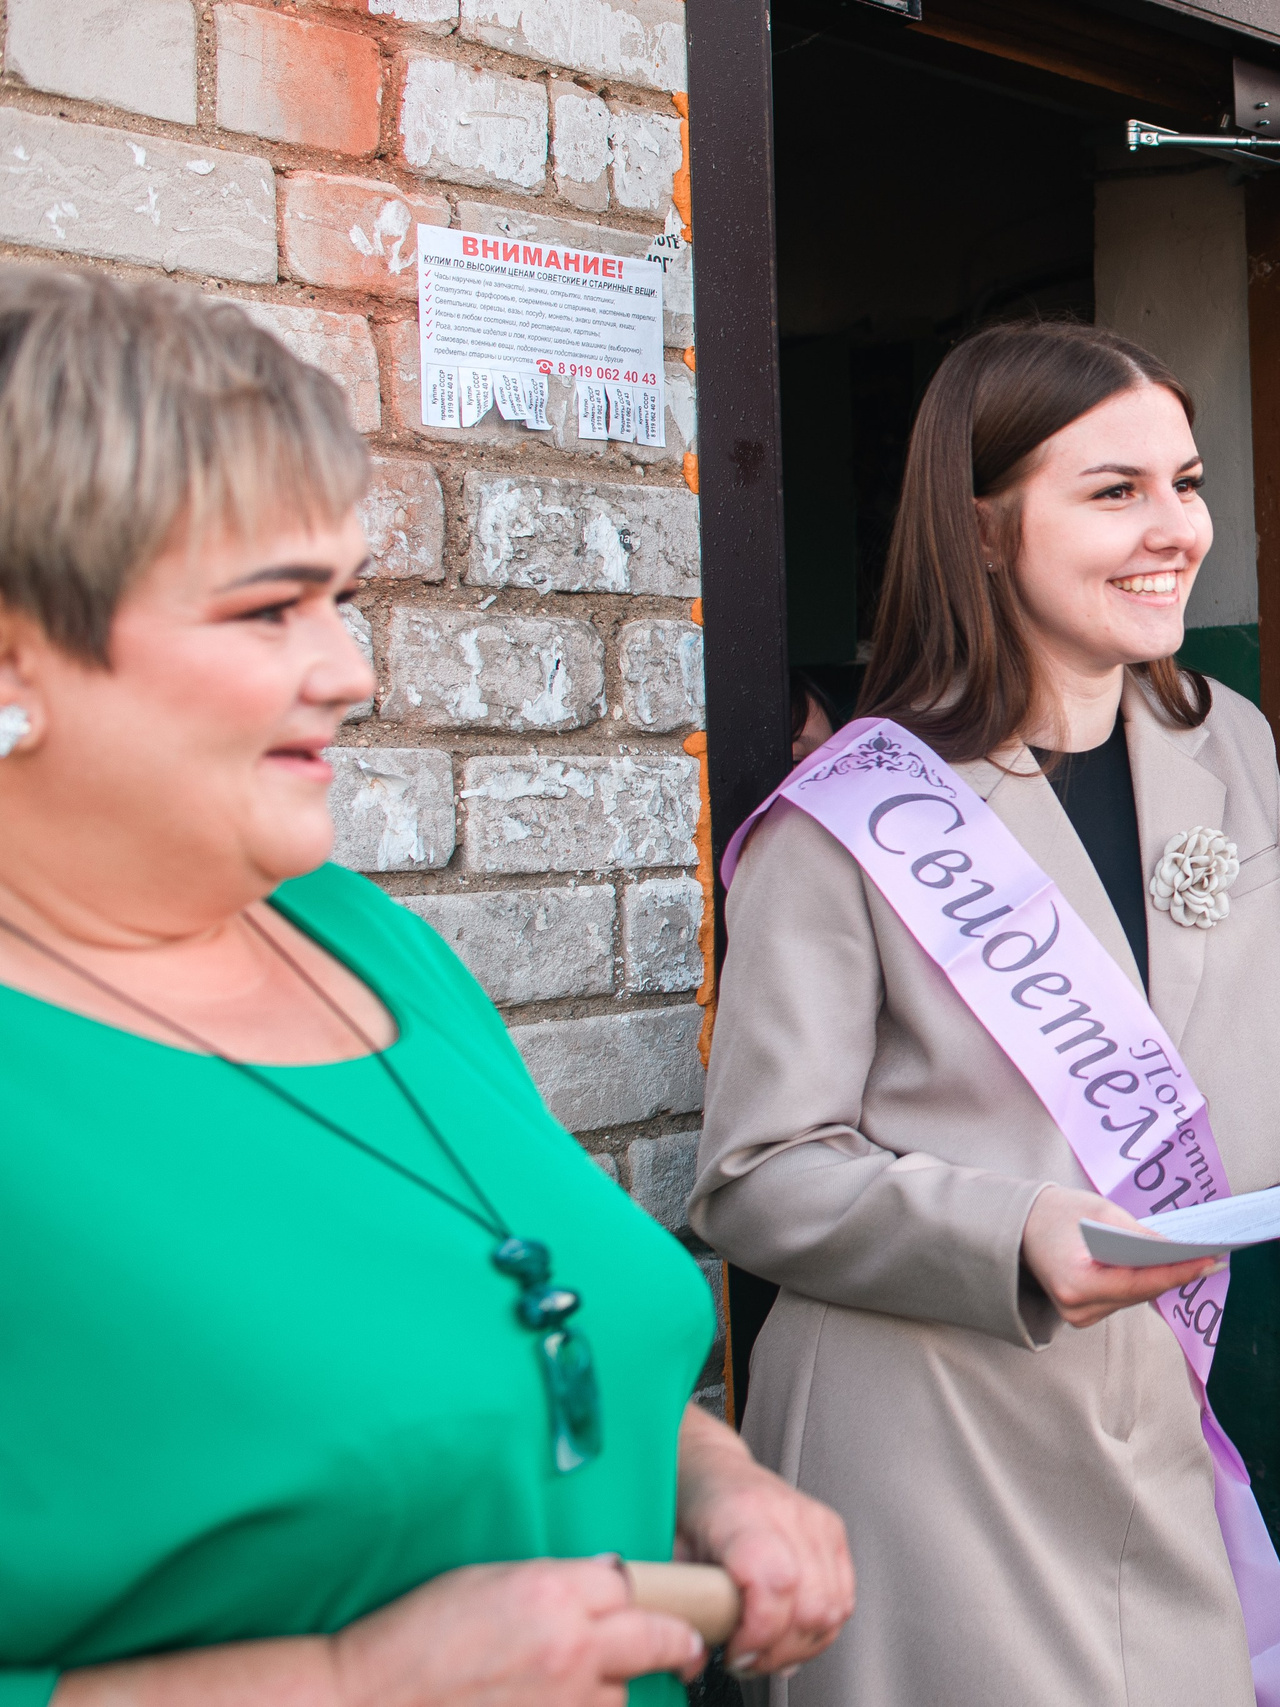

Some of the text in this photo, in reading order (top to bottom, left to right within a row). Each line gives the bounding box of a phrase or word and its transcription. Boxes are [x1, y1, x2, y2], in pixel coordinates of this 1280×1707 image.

[462, 236, 624, 279] ВНИМАНИЕ!
[424, 254, 451, 266] КУПИМ
[454, 259, 464, 268] ПО
[466, 262, 507, 274] ВЫСОКИМ
[508, 268, 536, 279] ЦЕНАМ
[537, 272, 580, 286] СОВЕТСКИЕ
[588, 280, 633, 294] СТАРИННЫЕ
[634, 286, 658, 298] ВЕЩИ:
[434, 271, 451, 280] Часы
[452, 274, 481, 285] наручные
[483, 279, 492, 287] (на
[528, 286, 549, 296] значки,
[550, 290, 582, 300] открытки,
[435, 284, 472, 296] Статуэтки
[519, 297, 558, 308] современные
[599, 309, 630, 318] настенные
[435, 296, 478, 310] Светильники,
[526, 310, 546, 319] посуду,
[435, 309, 455, 318] Иконы
[484, 316, 517, 327] состоянии,
[519, 320, 530, 328] под
[436, 322, 452, 330] Рога,
[454, 325, 481, 334] золотые
[483, 329, 507, 337] изделия
[554, 338, 580, 347] швейные
[581, 342, 606, 350] машинки
[436, 334, 469, 345] Самовары,
[471, 339, 496, 348] военные
[498, 342, 515, 351] вещи,
[517, 345, 553, 354] подсвечники
[554, 350, 598, 360] подстаканники
[604, 355, 623, 364] другие
[434, 347, 467, 356] предметы
[469, 351, 496, 360] старины
[558, 362, 656, 385] 8 919 062 40 43
